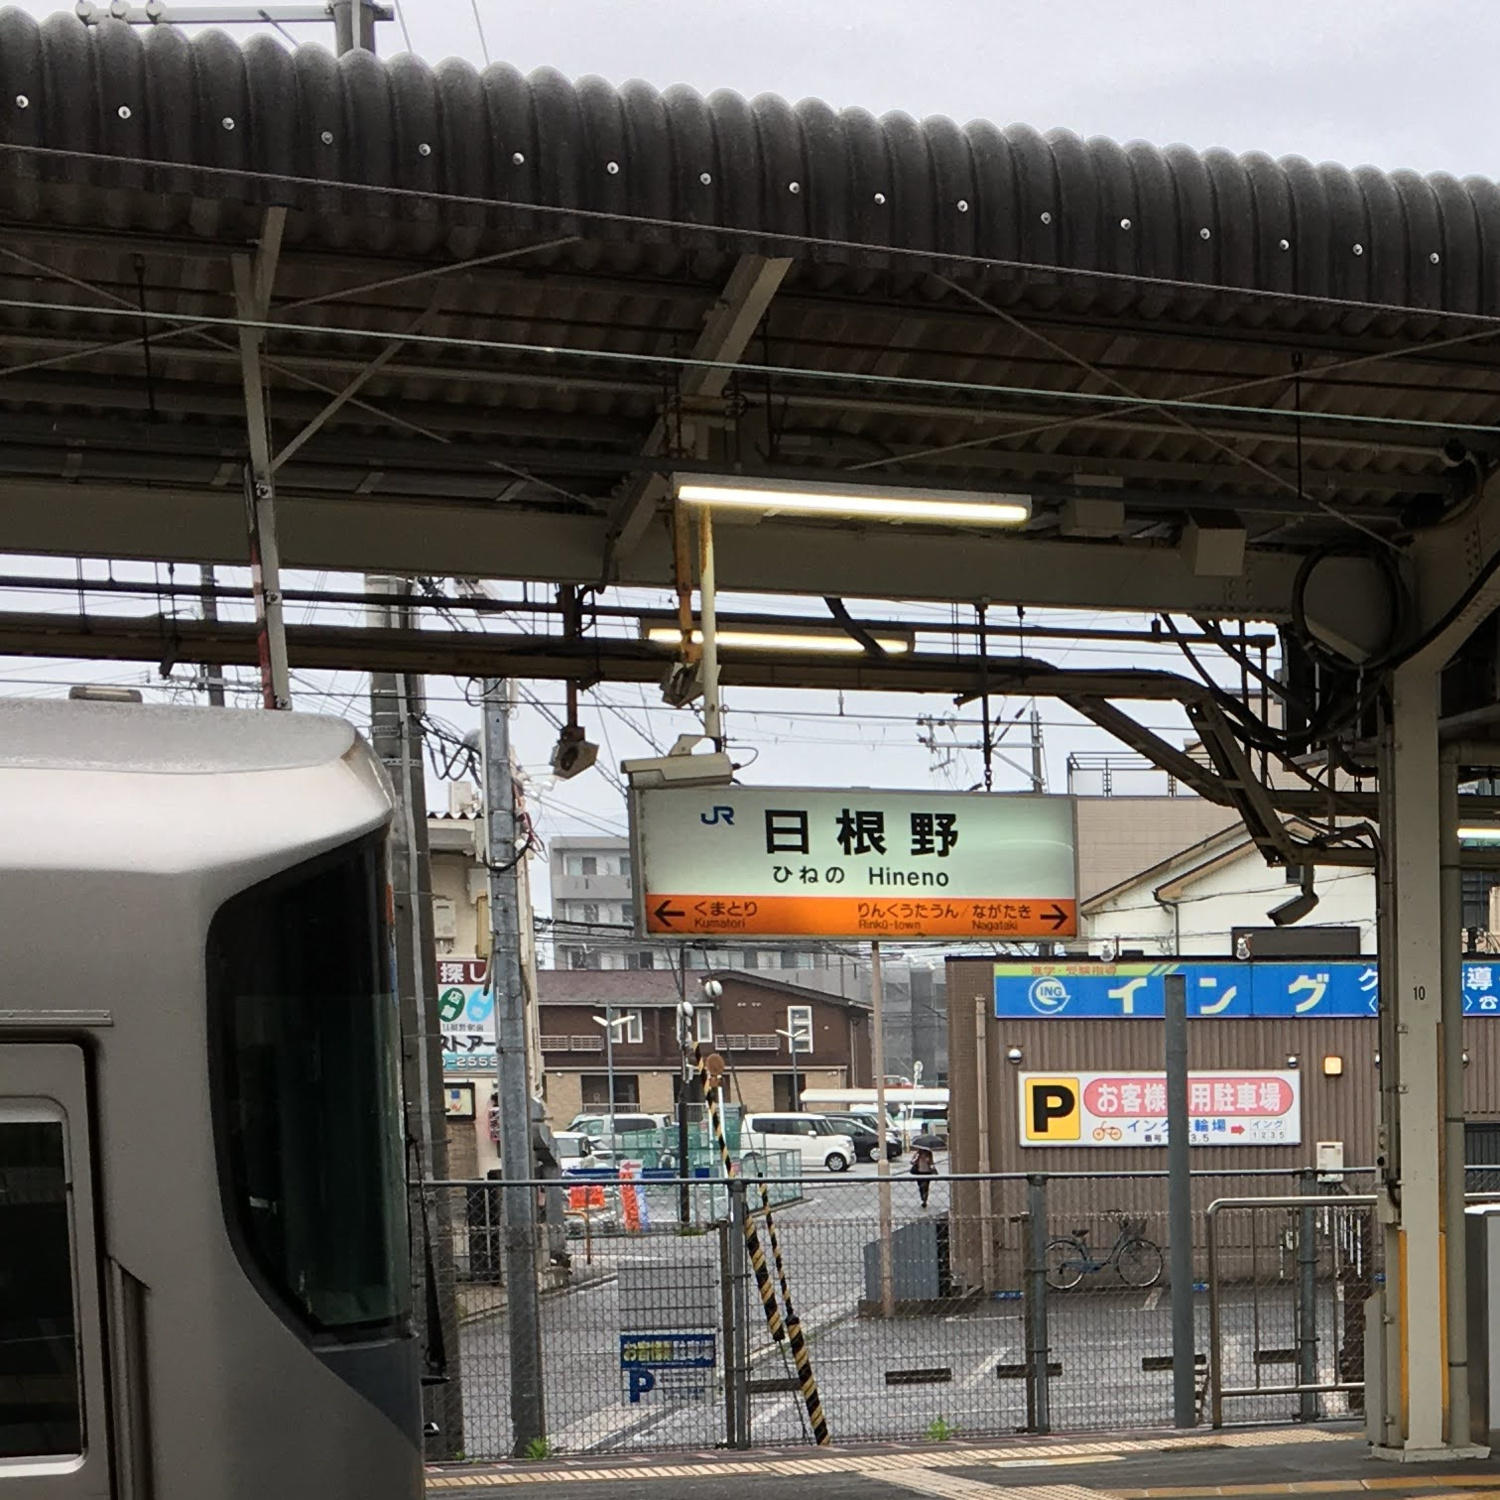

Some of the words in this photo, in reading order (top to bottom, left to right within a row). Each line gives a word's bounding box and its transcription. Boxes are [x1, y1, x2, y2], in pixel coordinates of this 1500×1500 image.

[700, 806, 735, 825] JR
[765, 808, 959, 857] 日根野
[773, 866, 845, 884] ひねの
[869, 867, 949, 887] Hineno
[694, 902, 758, 917] くまとり
[858, 903, 959, 919] りんくうたうん
[973, 905, 1031, 919] ながたき
[694, 917, 746, 928] Kumatori
[972, 920, 1018, 931] Nagataki
[1040, 986, 1063, 996] ING
[1108, 973, 1330, 1015] イング
[1413, 986, 1426, 1000] 10
[1097, 1083, 1282, 1113] お客様用駐車場
[1032, 1085, 1075, 1133] P
[629, 1368, 655, 1403] P
